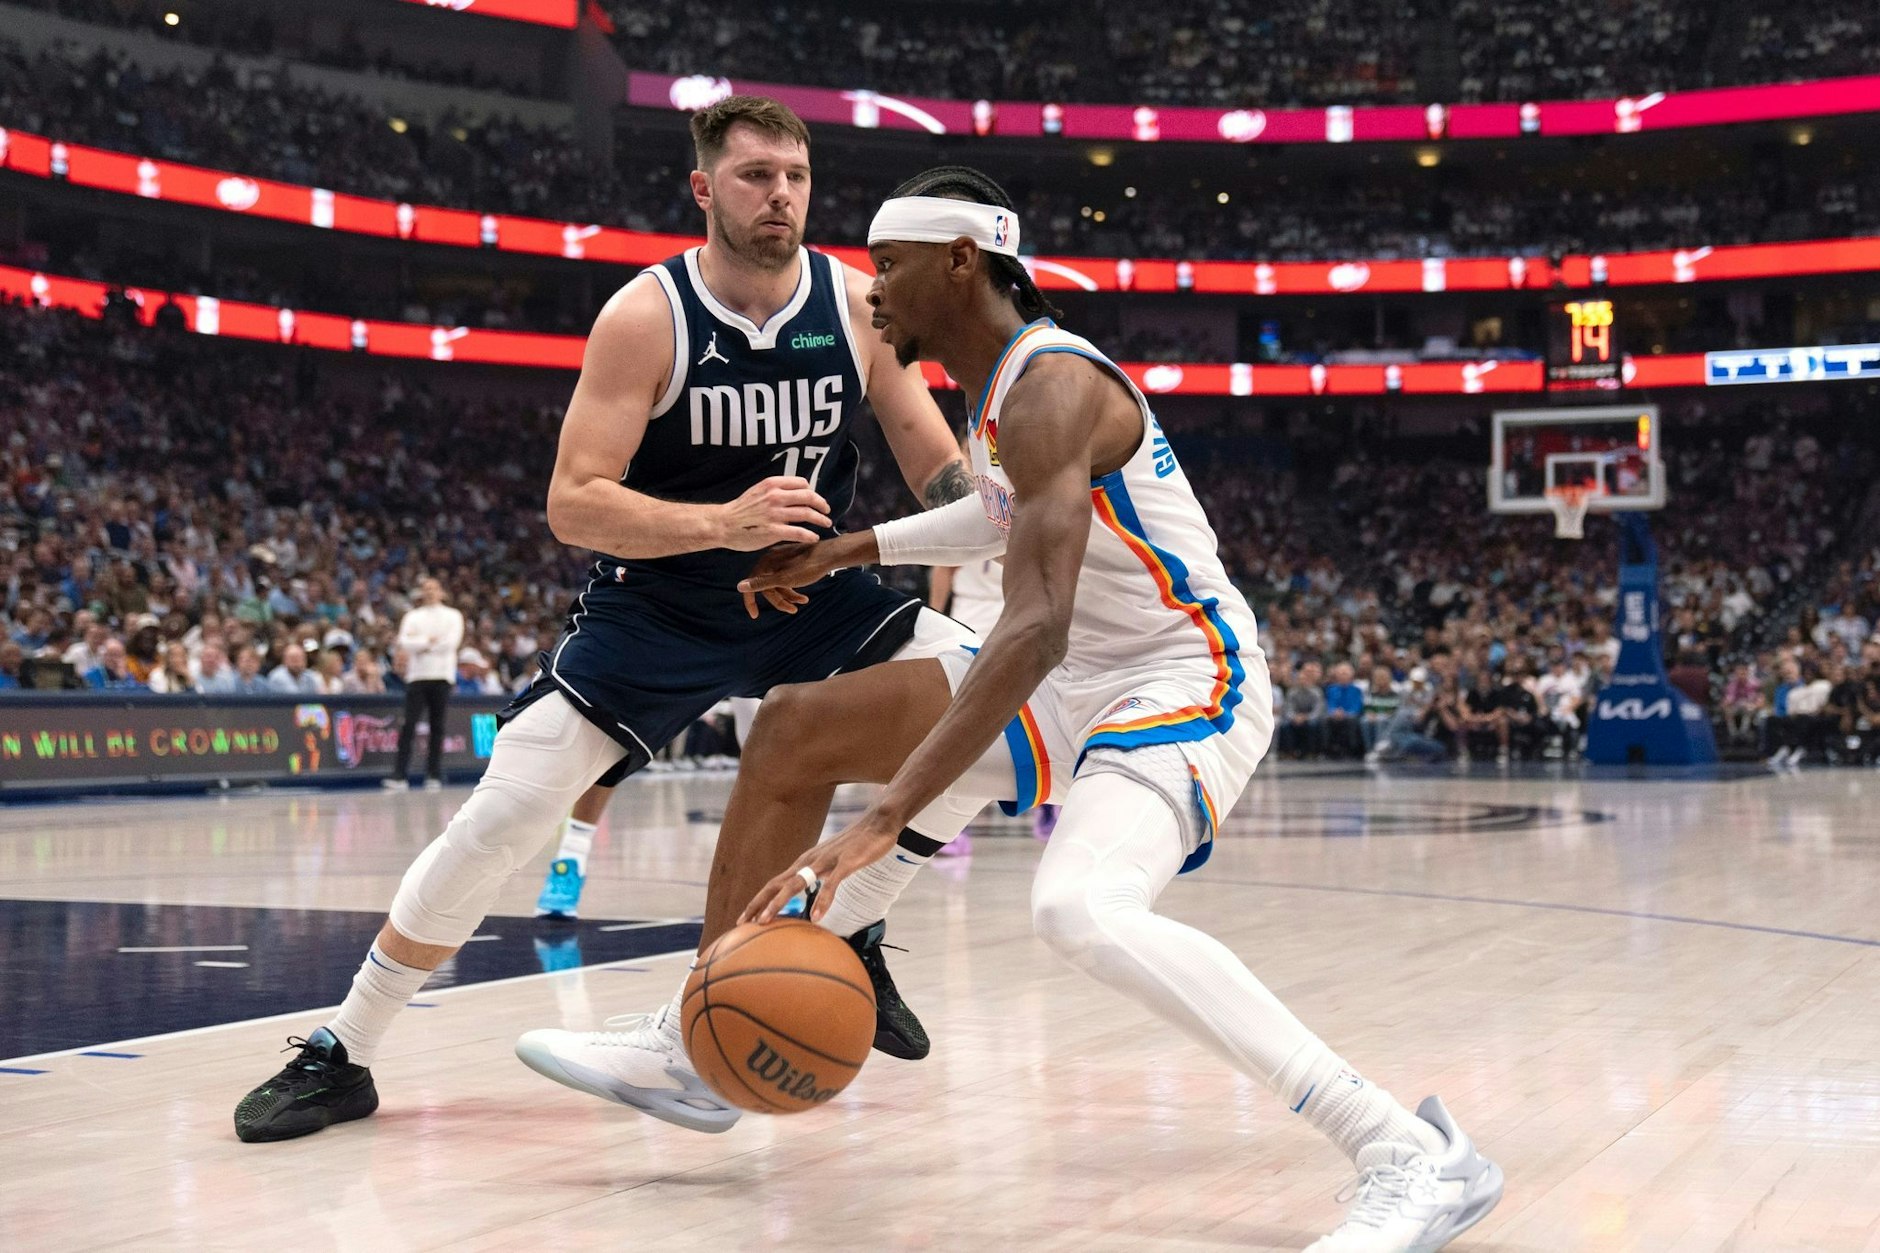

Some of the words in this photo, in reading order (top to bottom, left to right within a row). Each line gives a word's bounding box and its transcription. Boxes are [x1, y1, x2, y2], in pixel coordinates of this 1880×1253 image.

[791, 332, 836, 349] chime
[1571, 324, 1610, 362] 14
[689, 374, 843, 447] MAVS
[770, 446, 831, 492] 17
[31, 730, 99, 759] WILL
[150, 727, 279, 757] CROWNED
[746, 1036, 842, 1104] Wilso
